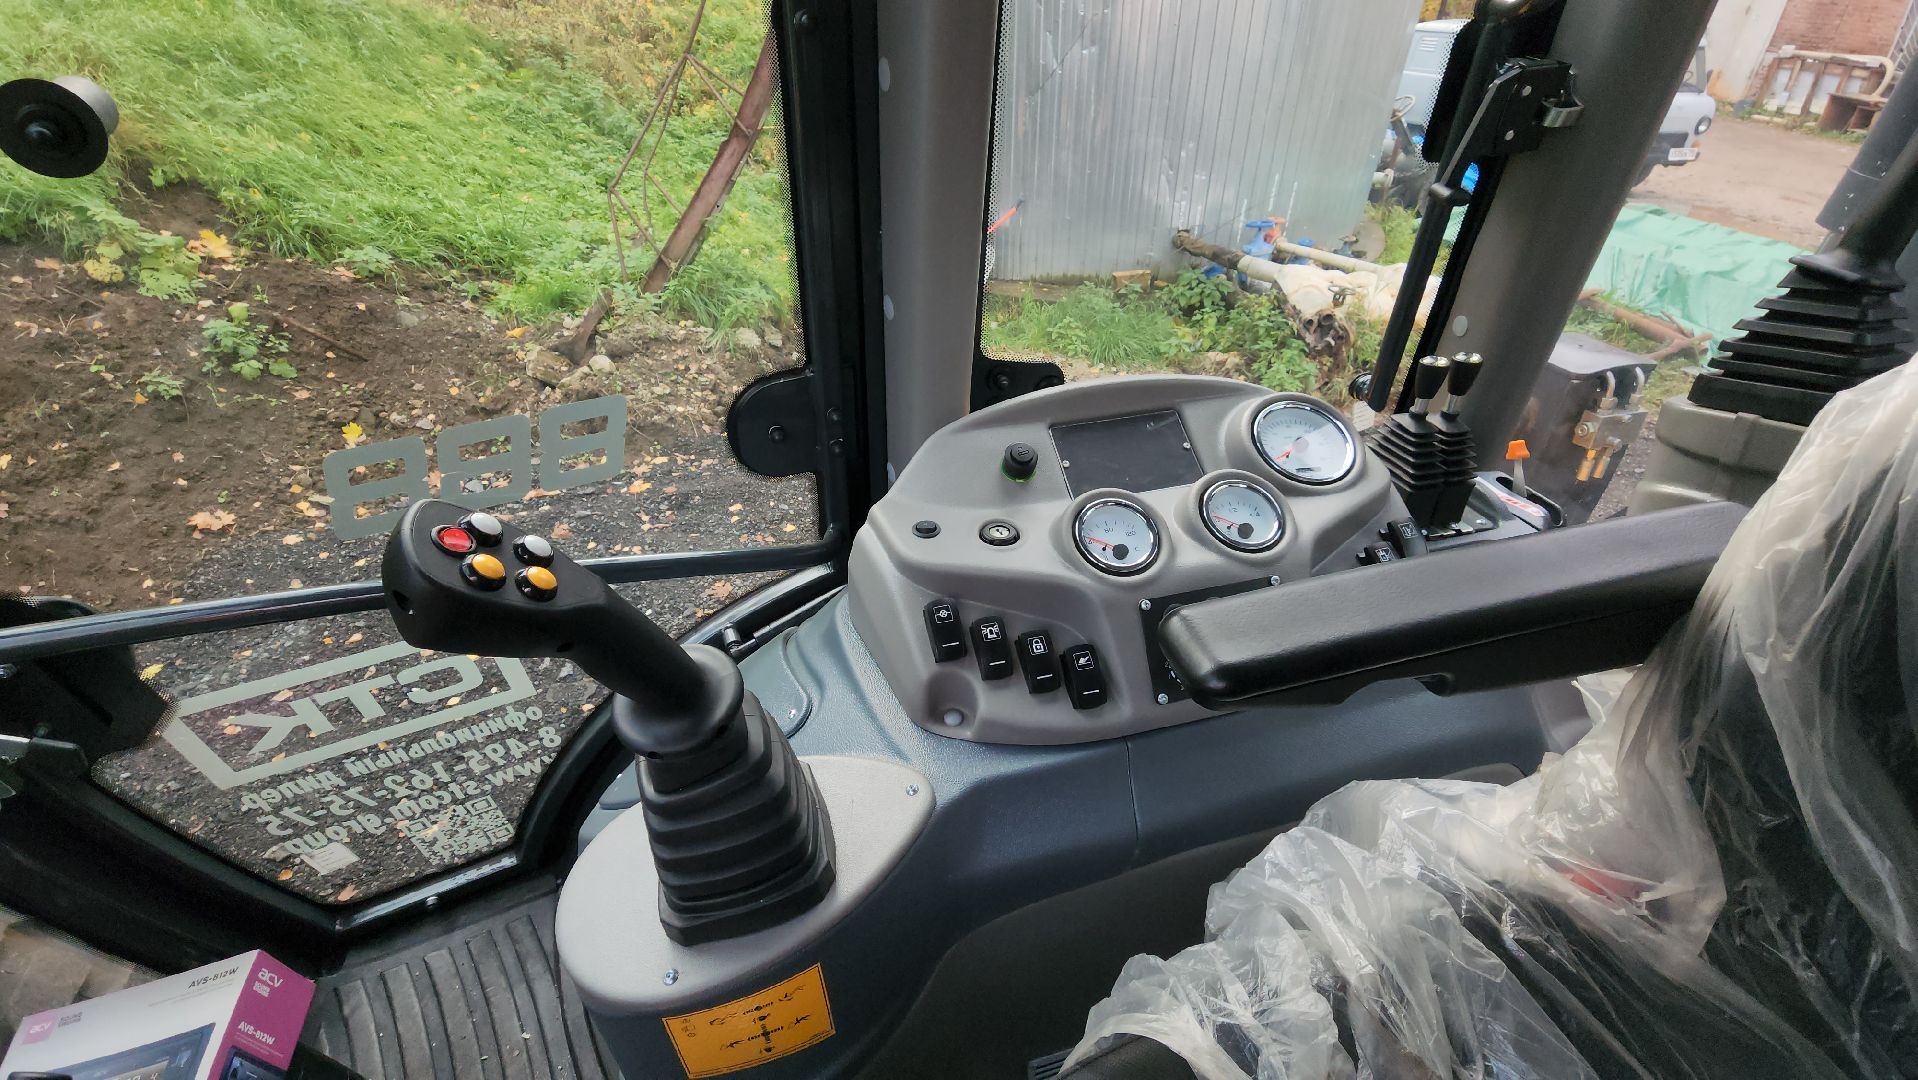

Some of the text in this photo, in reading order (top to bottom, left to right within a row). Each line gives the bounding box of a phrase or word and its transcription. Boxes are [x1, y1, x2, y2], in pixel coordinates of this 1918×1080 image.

[187, 966, 240, 989] AVS-812W
[257, 967, 284, 988] acv
[237, 1020, 276, 1045] AVS-812W
